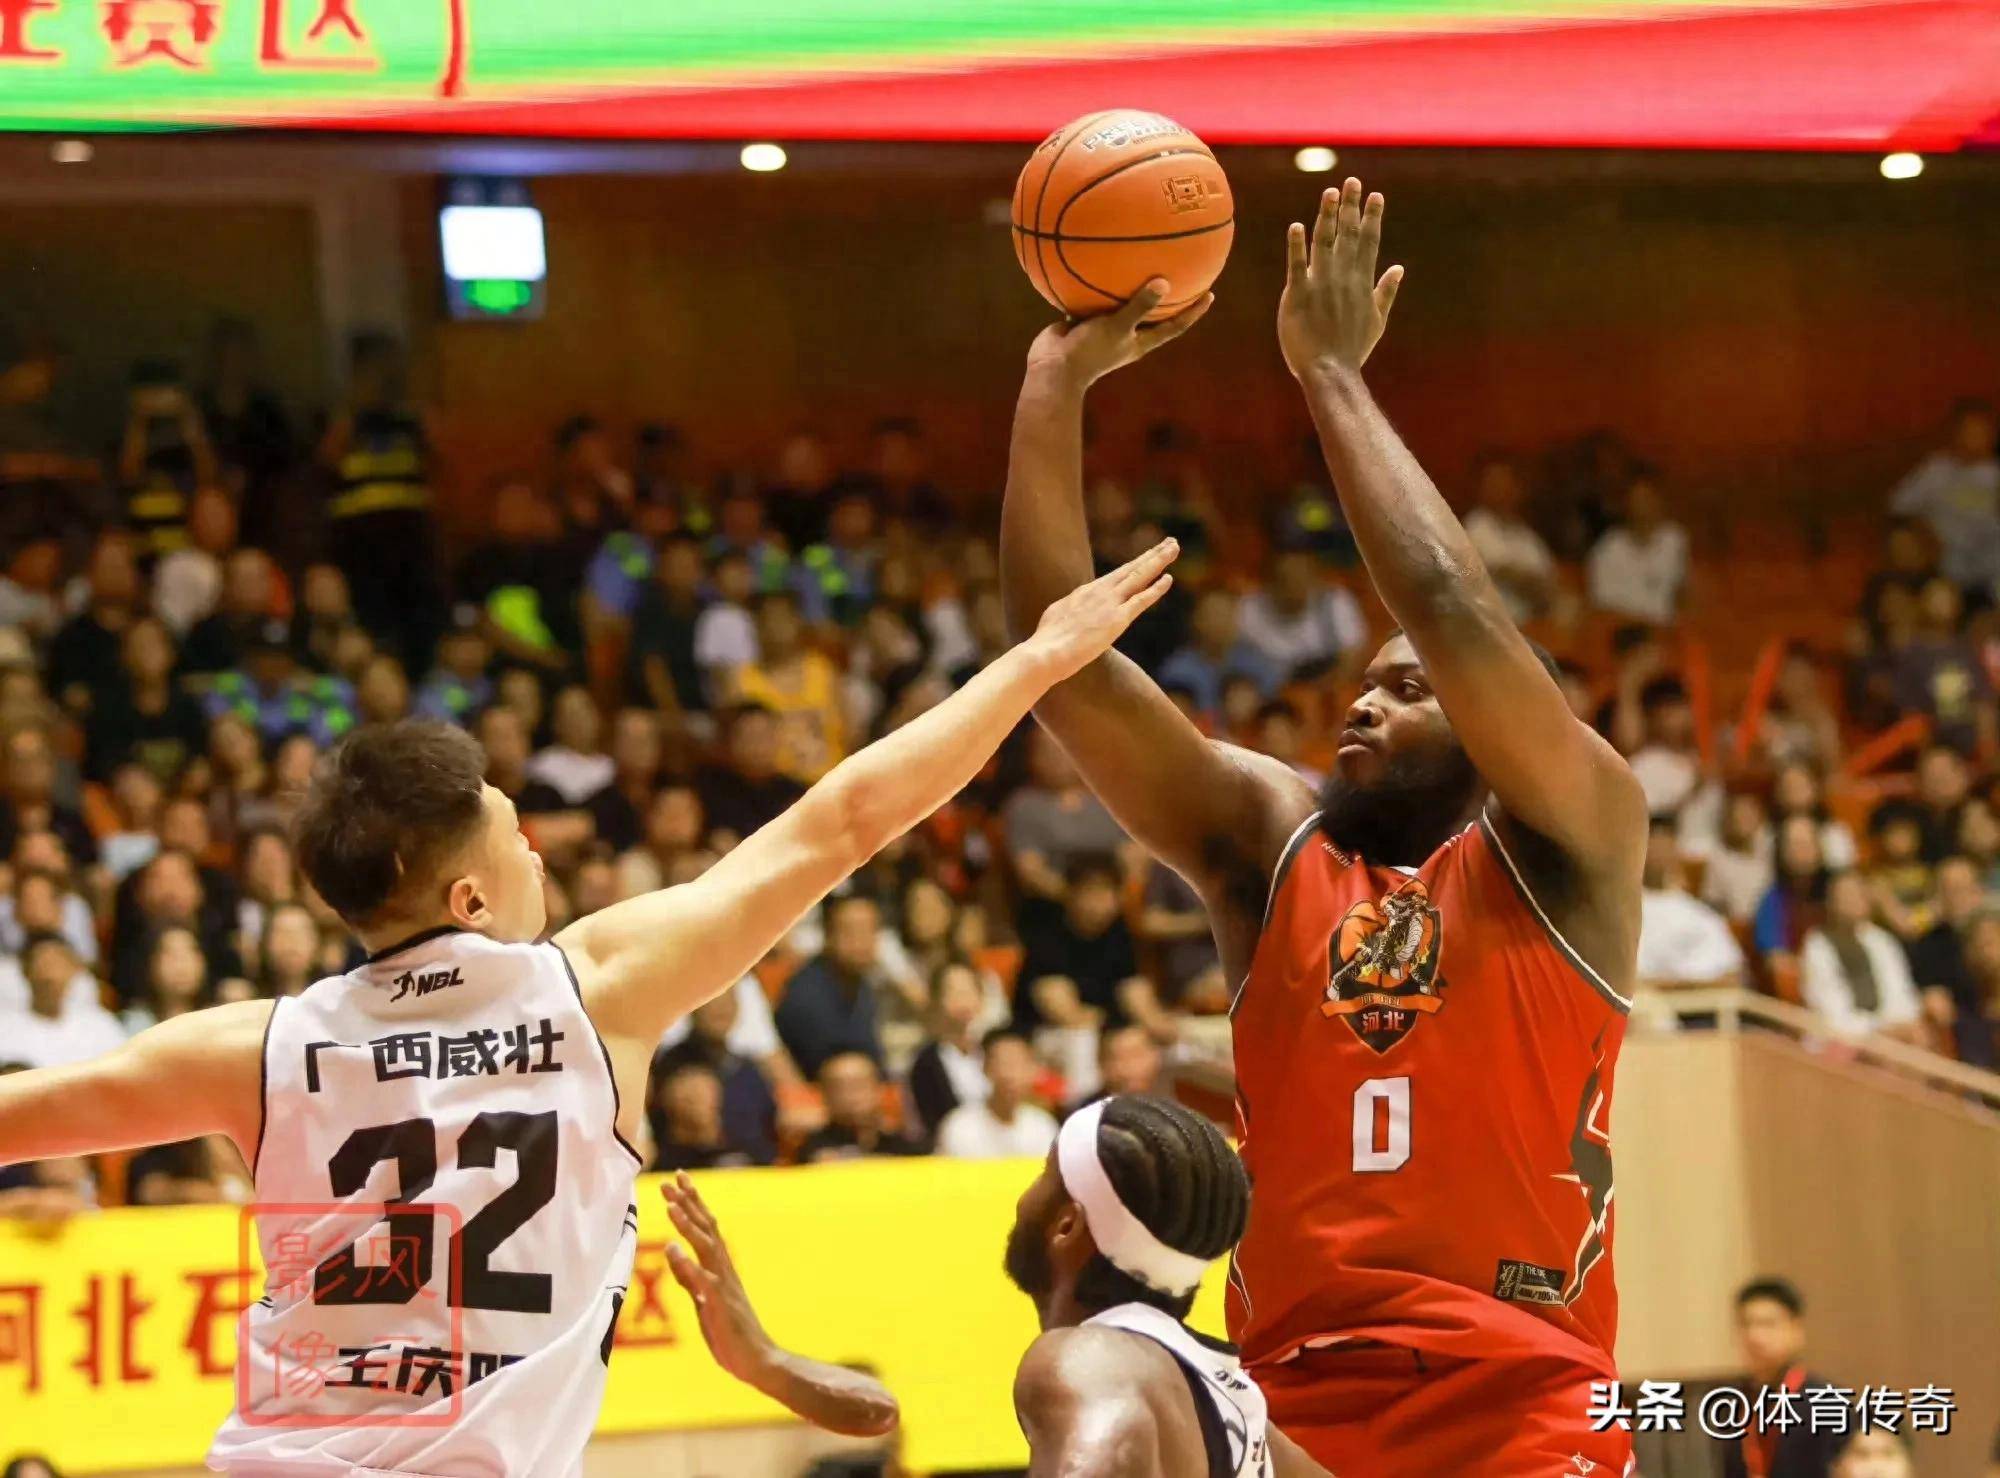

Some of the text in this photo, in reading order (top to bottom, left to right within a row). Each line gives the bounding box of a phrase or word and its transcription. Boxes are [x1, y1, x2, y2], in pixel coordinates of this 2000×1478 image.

[416, 967, 464, 997] NBL
[305, 1018, 565, 1092] 广西威壮
[1362, 1011, 1404, 1033] 河北
[1353, 1076, 1410, 1172] 0
[314, 1110, 558, 1313] 32
